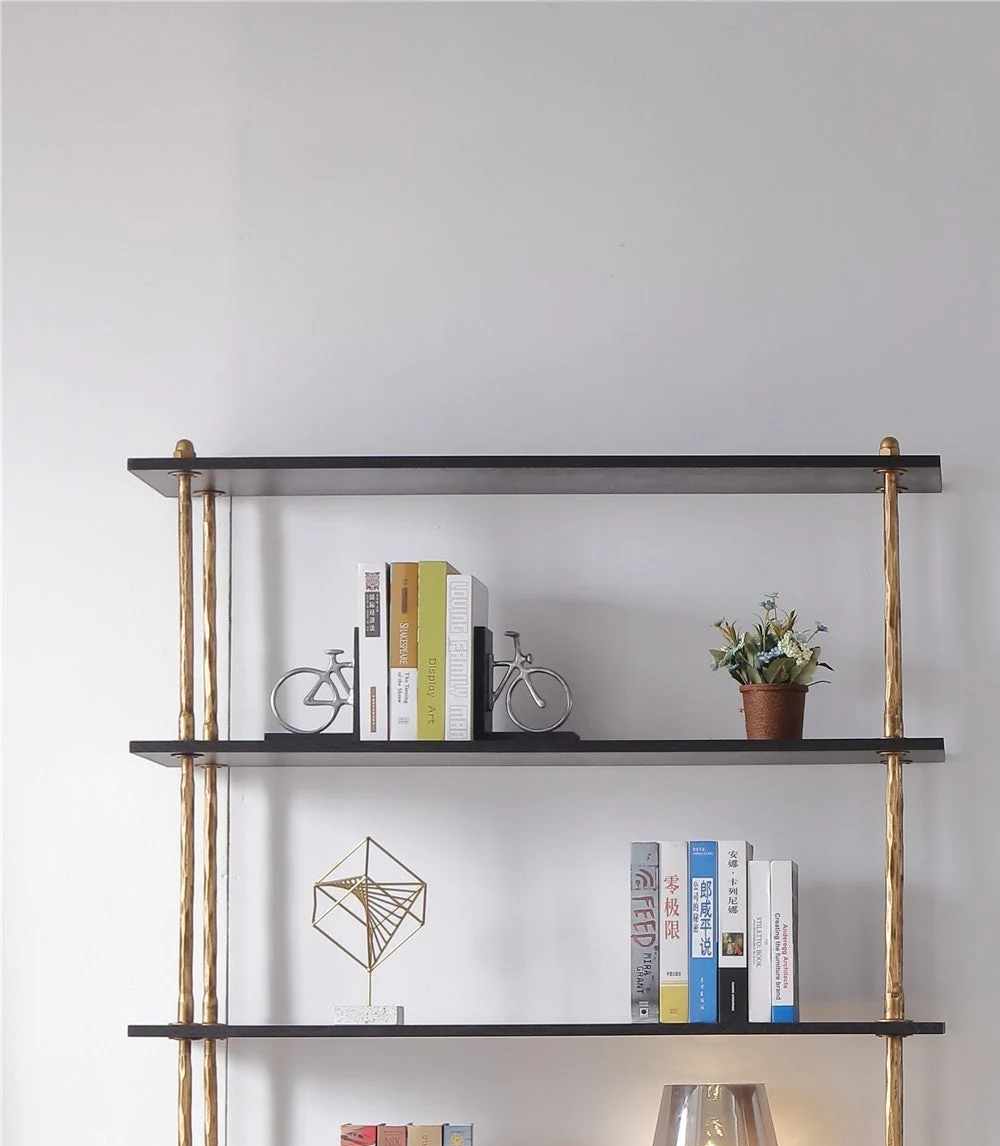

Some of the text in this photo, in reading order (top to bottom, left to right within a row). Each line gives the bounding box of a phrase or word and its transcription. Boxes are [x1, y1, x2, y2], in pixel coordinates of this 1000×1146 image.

[427, 657, 437, 725] Display Art
[631, 896, 656, 948] FEED
[663, 874, 680, 940] 零极限
[699, 879, 713, 956] 郎咸平说
[636, 966, 645, 994] GRANT
[644, 952, 652, 976] MIRA
